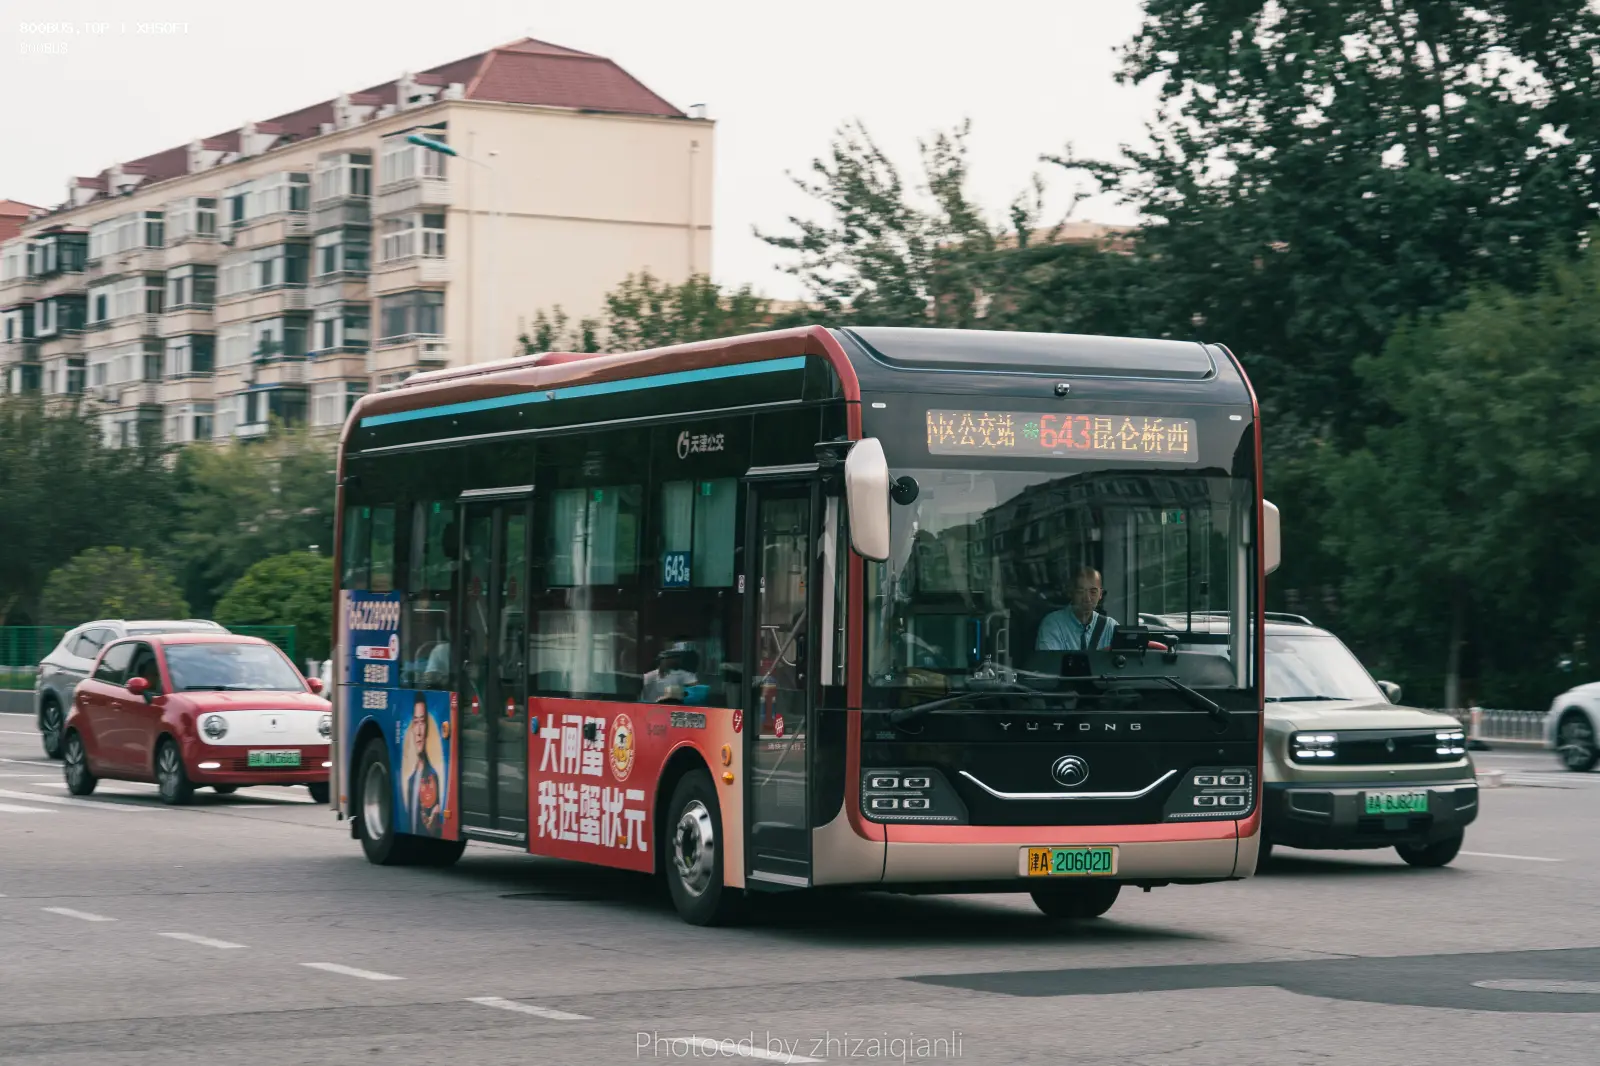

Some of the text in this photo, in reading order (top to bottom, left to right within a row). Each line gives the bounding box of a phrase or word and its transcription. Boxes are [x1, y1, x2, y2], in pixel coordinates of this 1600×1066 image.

[690, 433, 725, 453] 天津公交
[1040, 414, 1091, 449] 643
[1093, 416, 1189, 454] 昆仑桥西
[539, 713, 607, 777] 大闸蟹
[1000, 721, 1142, 732] YUTONG
[537, 780, 648, 852] 我选蟹状元
